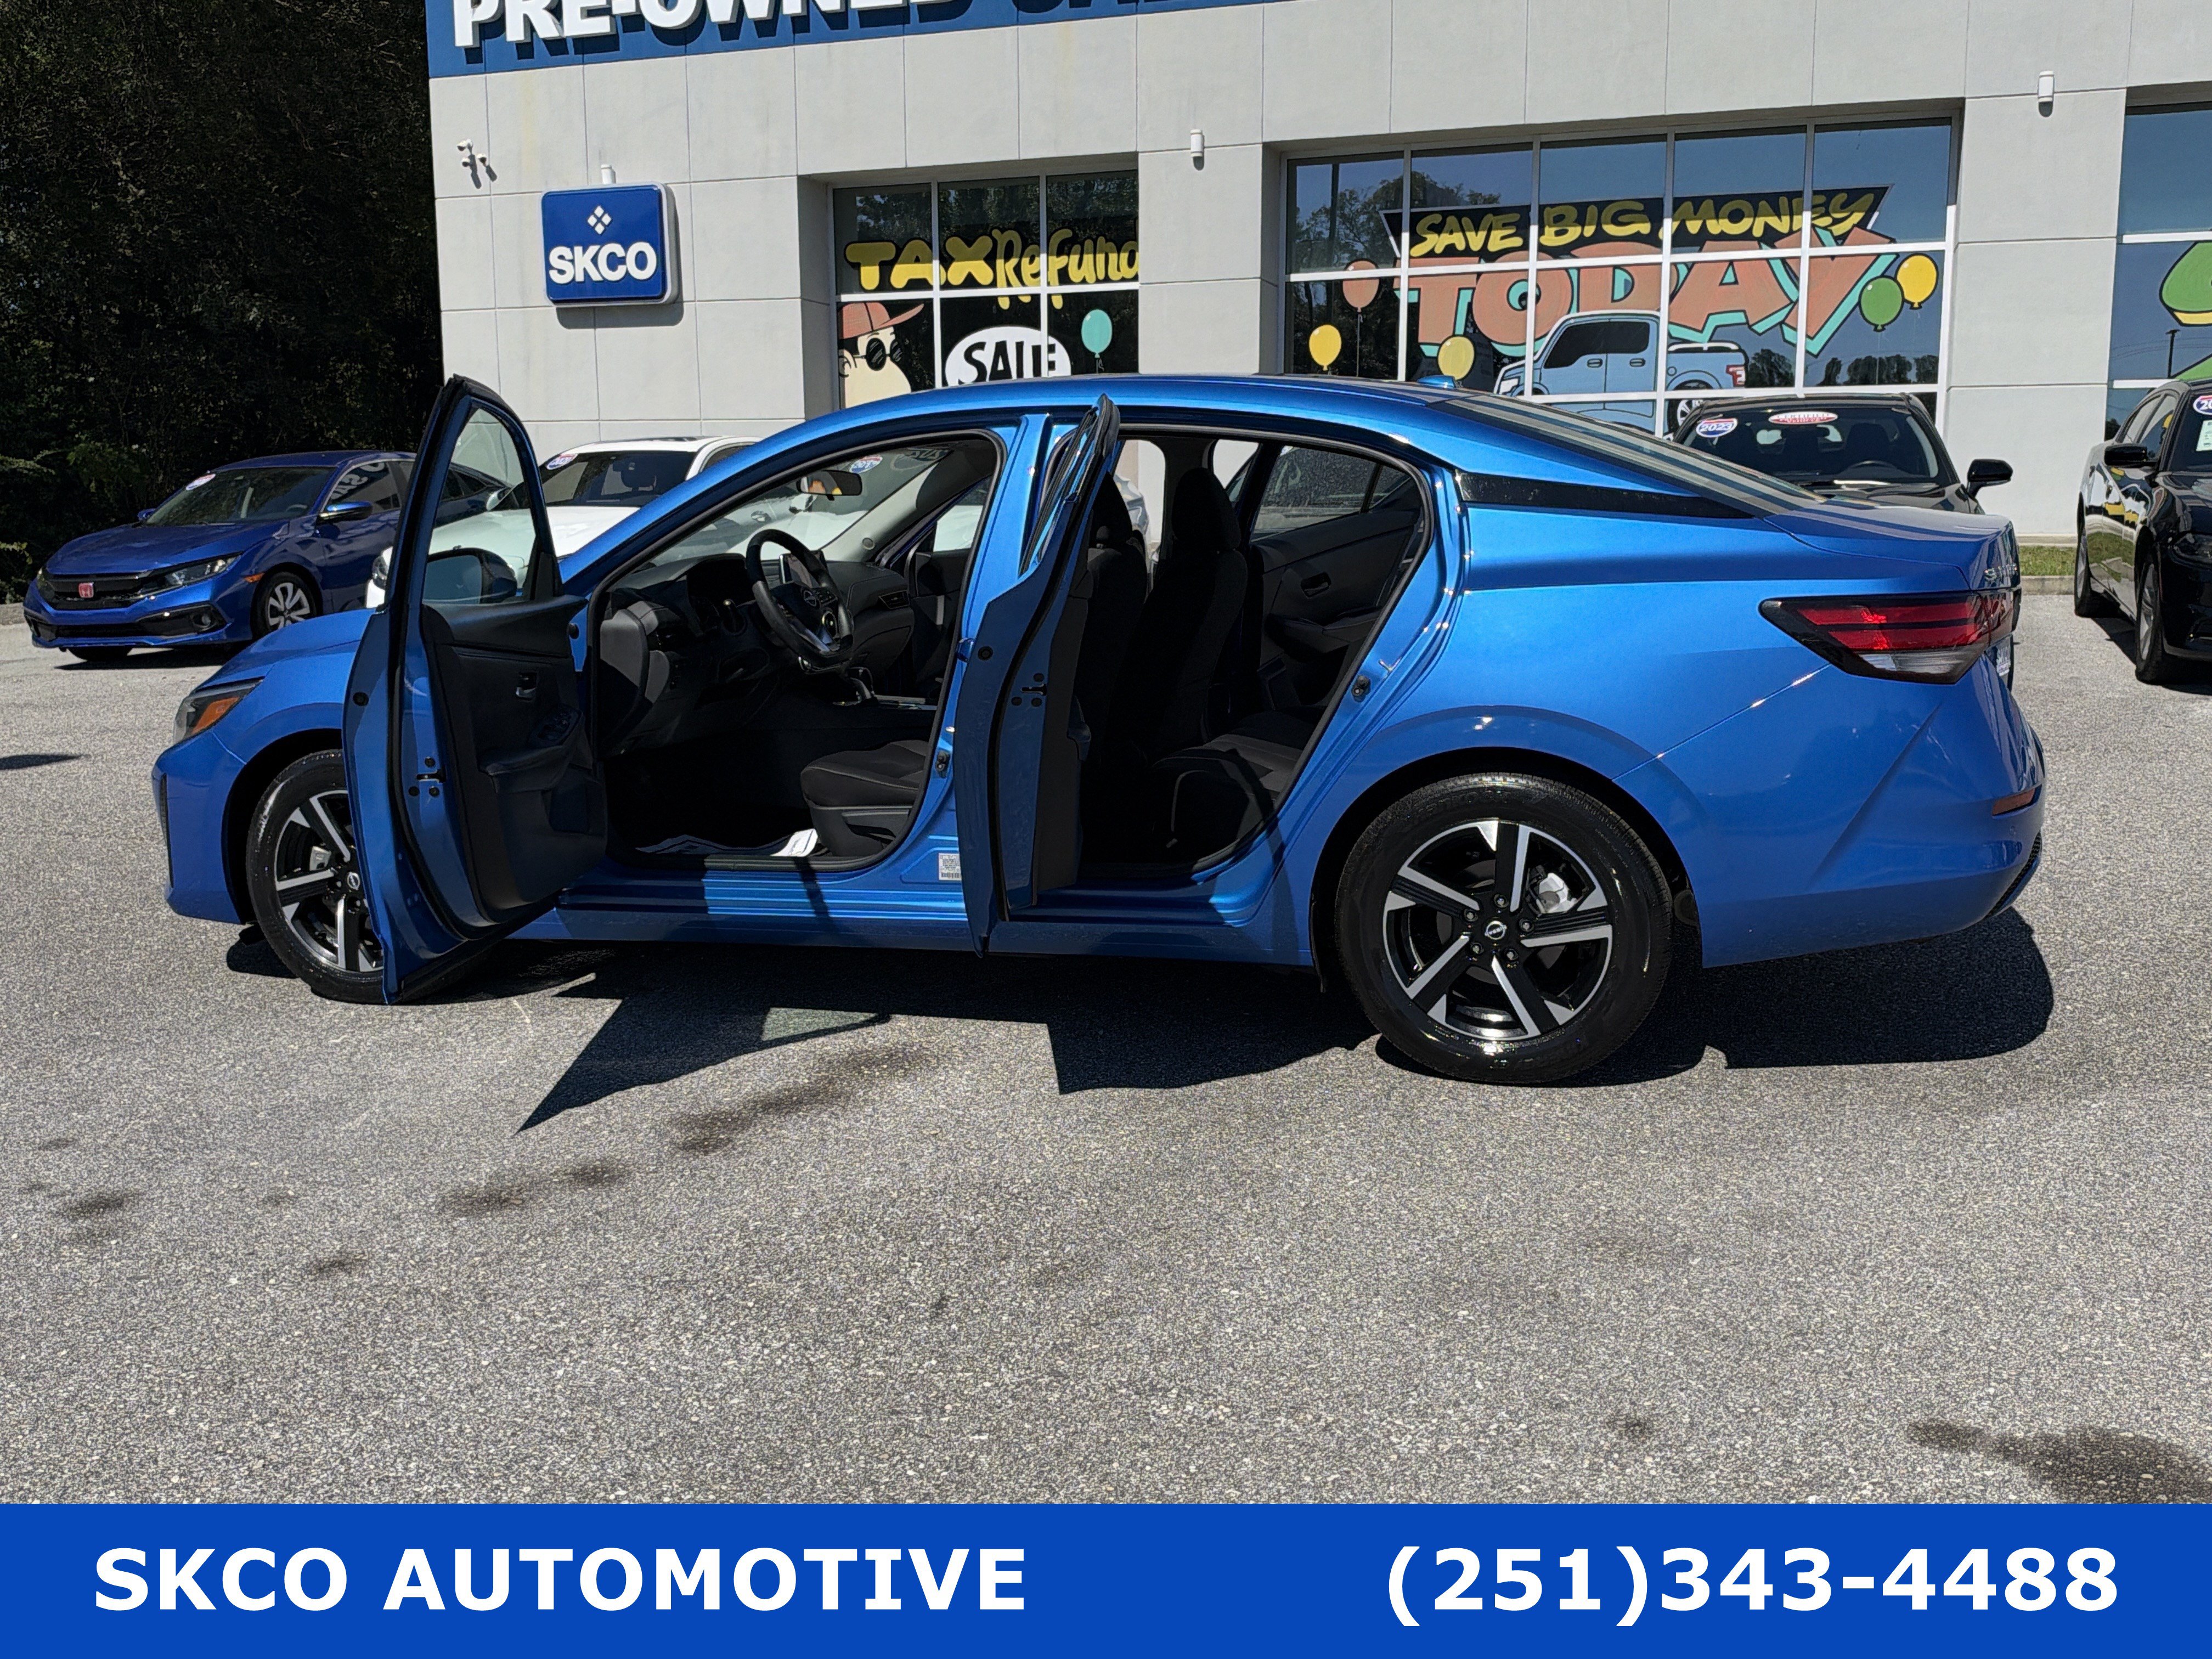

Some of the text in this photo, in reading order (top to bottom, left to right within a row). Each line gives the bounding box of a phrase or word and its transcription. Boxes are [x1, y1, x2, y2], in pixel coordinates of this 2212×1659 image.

[1410, 192, 1874, 257] SAVE BIG MONEY
[549, 241, 657, 284] SKCO
[845, 235, 994, 290] TAX
[1395, 226, 1896, 351] TODAY
[958, 340, 1056, 384] SALE
[1699, 423, 1733, 432] 2023
